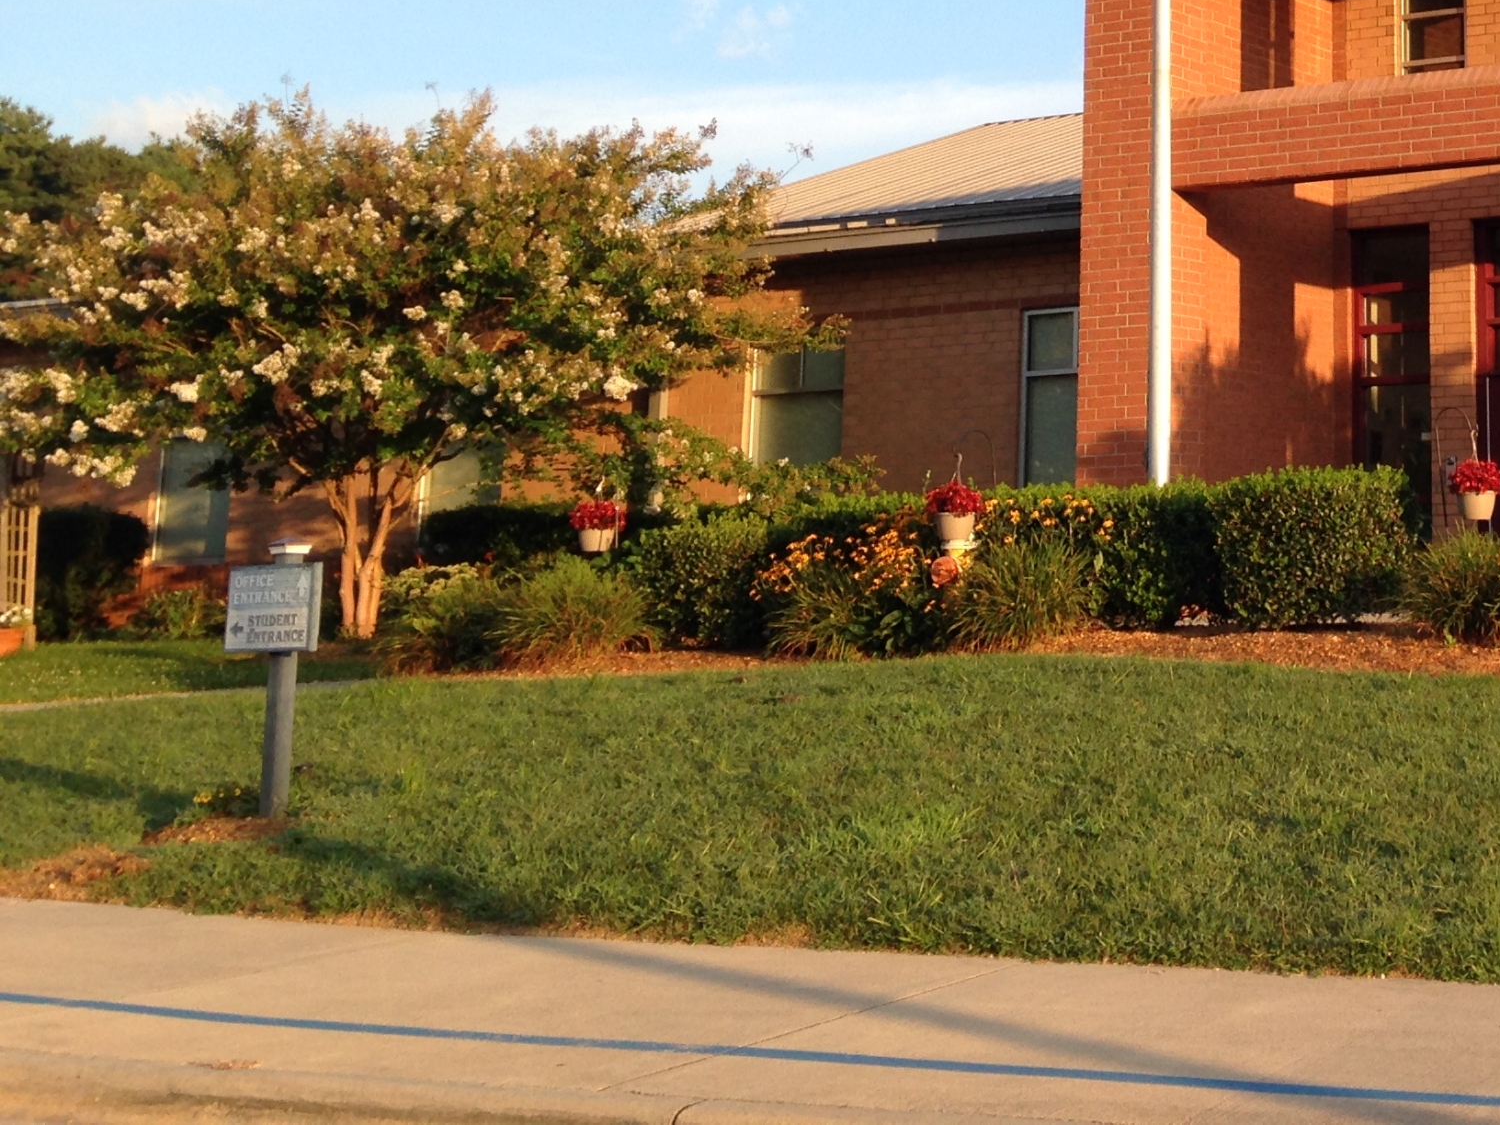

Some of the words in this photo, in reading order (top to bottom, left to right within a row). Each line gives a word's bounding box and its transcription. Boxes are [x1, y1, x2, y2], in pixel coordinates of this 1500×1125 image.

[235, 574, 274, 588] OFFICE
[233, 590, 292, 604] ENTRANCE
[248, 613, 298, 627] STUDENT
[247, 629, 305, 644] ENTRANCE
